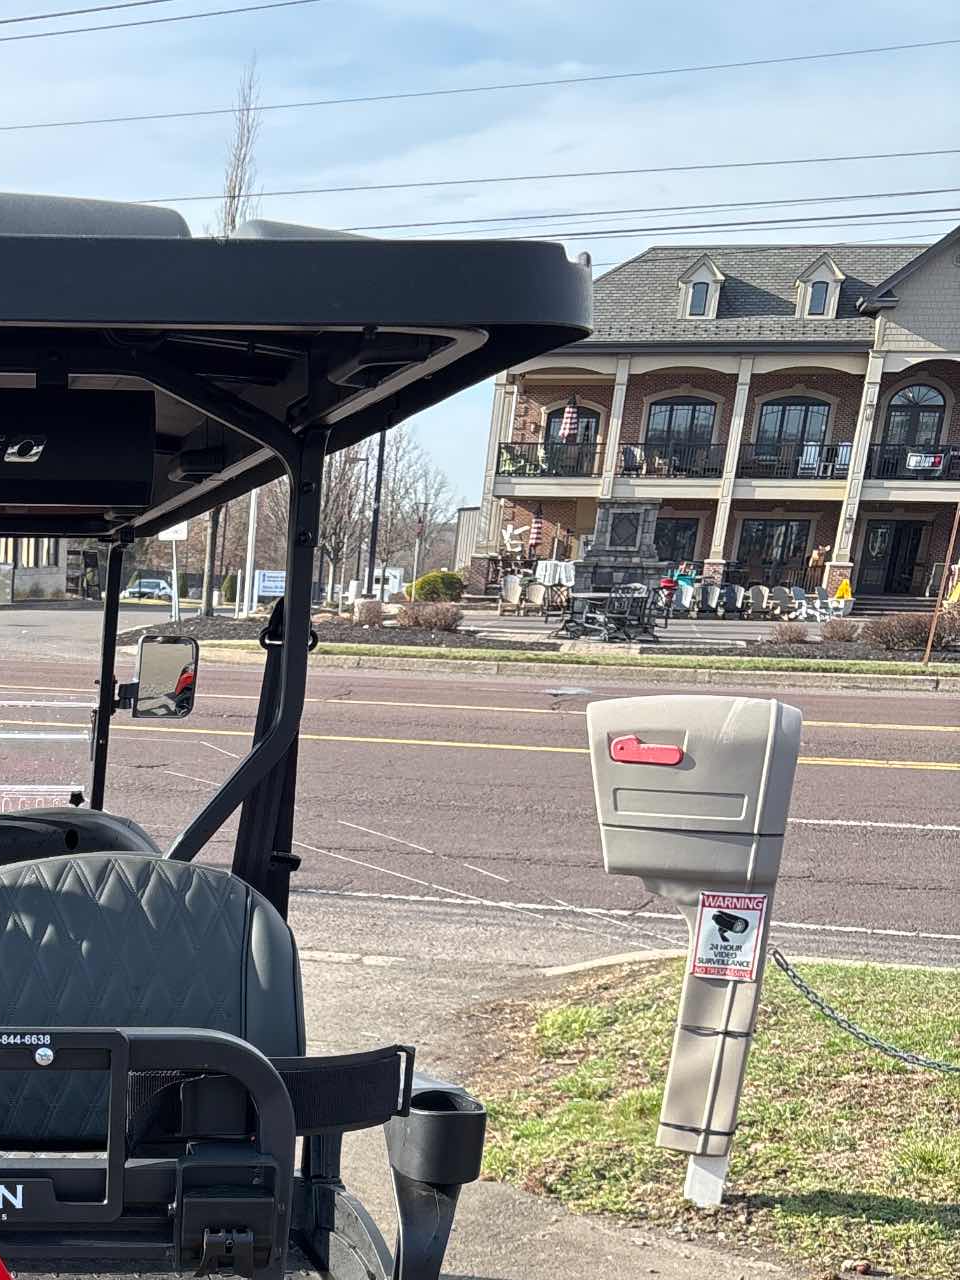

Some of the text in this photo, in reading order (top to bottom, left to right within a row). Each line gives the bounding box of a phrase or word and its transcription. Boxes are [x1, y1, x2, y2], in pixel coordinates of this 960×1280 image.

[703, 895, 763, 910] WARNING
[709, 943, 743, 953] 24 HOUR
[713, 951, 737, 959] VIDEO
[697, 957, 751, 967] SURVEILLANCE
[706, 967, 752, 978] TRESPASSING
